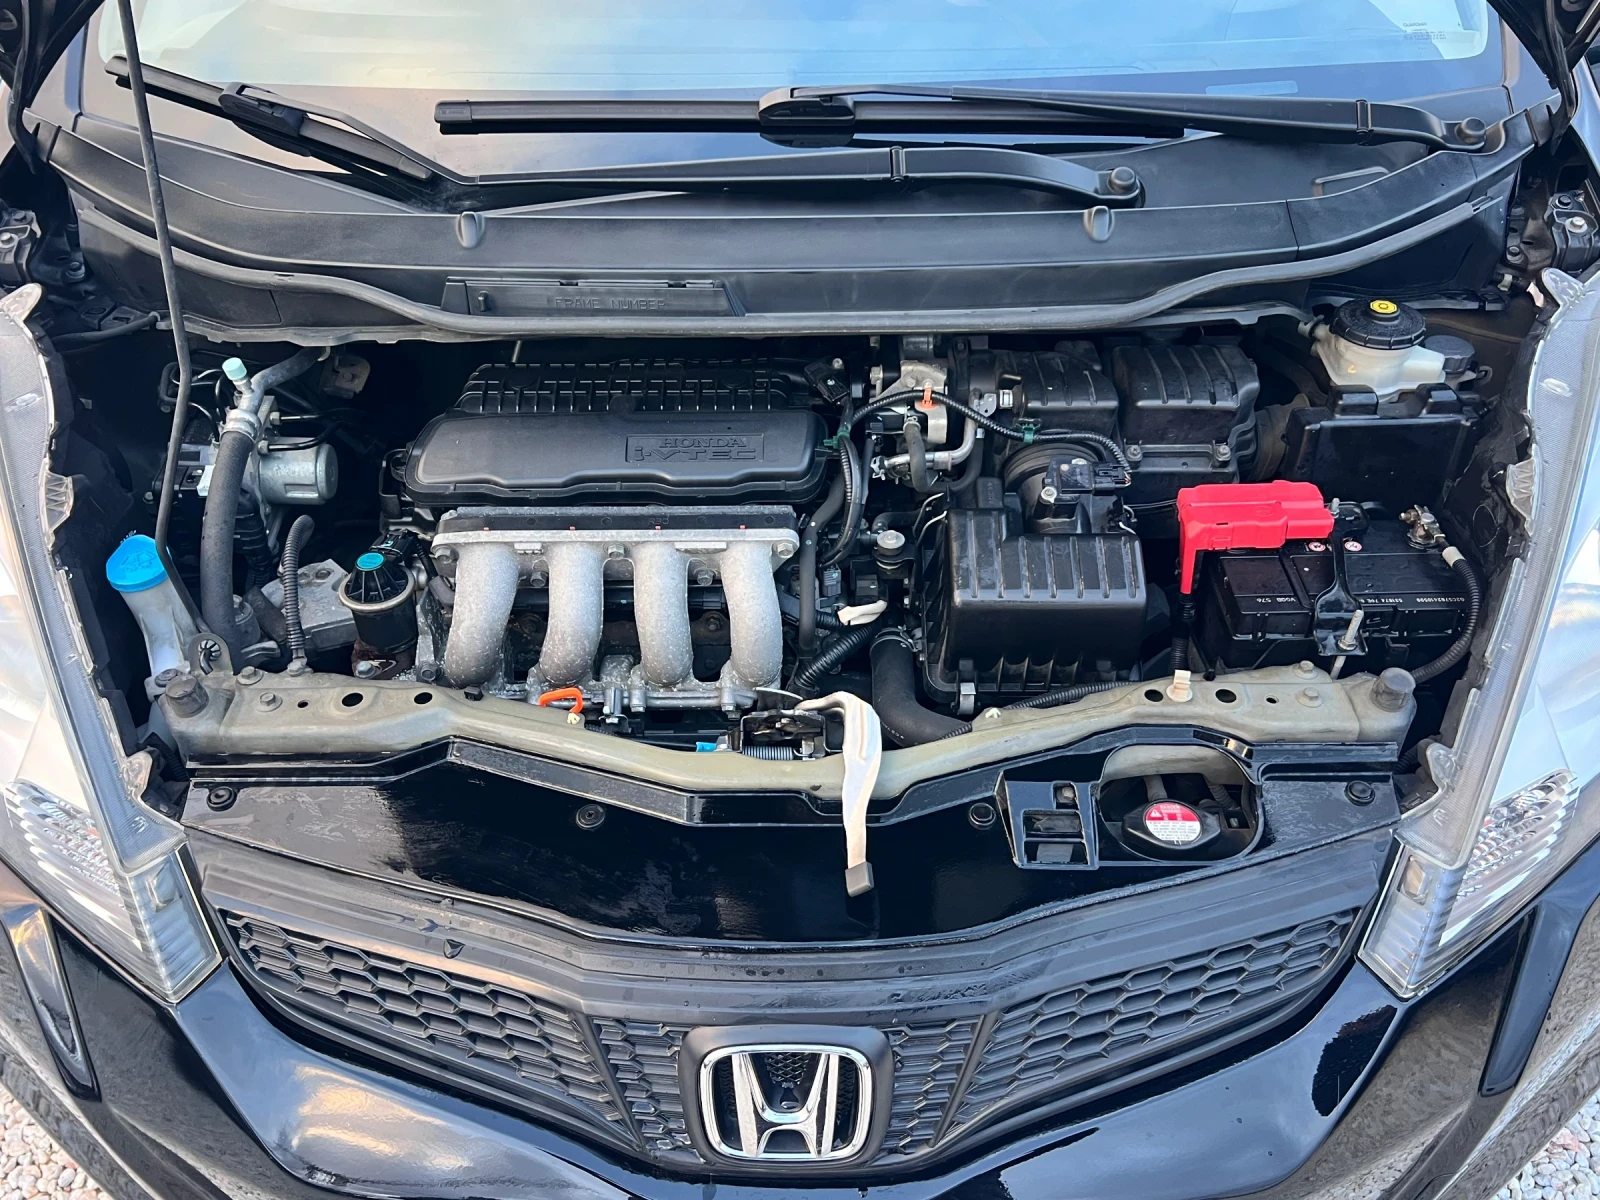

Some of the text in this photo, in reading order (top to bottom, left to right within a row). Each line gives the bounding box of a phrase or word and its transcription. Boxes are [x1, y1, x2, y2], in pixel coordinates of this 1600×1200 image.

[555, 297, 665, 310] FRAME NUMBER
[659, 438, 746, 448] HONDA
[634, 446, 756, 461] i-VTEC
